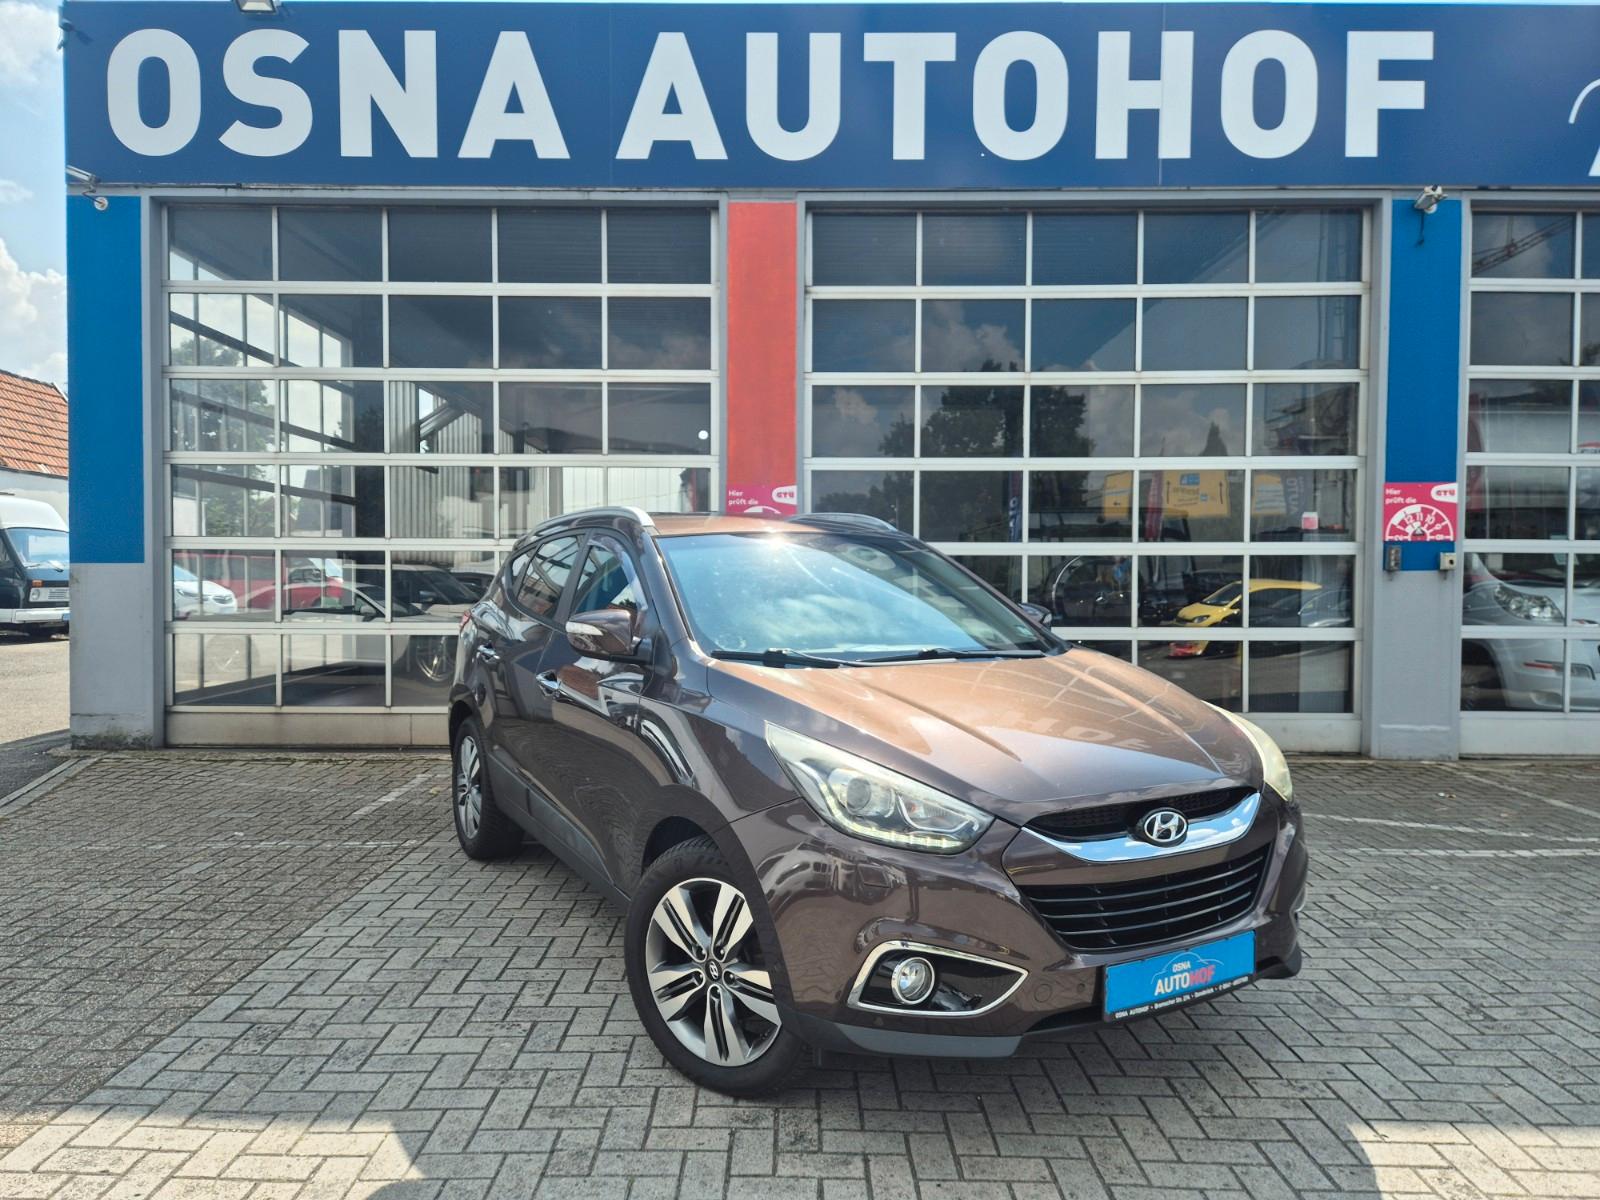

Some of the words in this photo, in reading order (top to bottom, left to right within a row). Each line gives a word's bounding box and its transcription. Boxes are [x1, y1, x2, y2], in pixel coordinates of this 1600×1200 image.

[107, 28, 570, 159] OSNA
[615, 29, 1434, 161] AUTOHOF
[728, 498, 746, 506] prüft
[1385, 497, 1404, 505] prüft
[1405, 496, 1417, 504] die
[1172, 960, 1191, 973] OSNA
[1154, 964, 1216, 996] AUTOHOF
